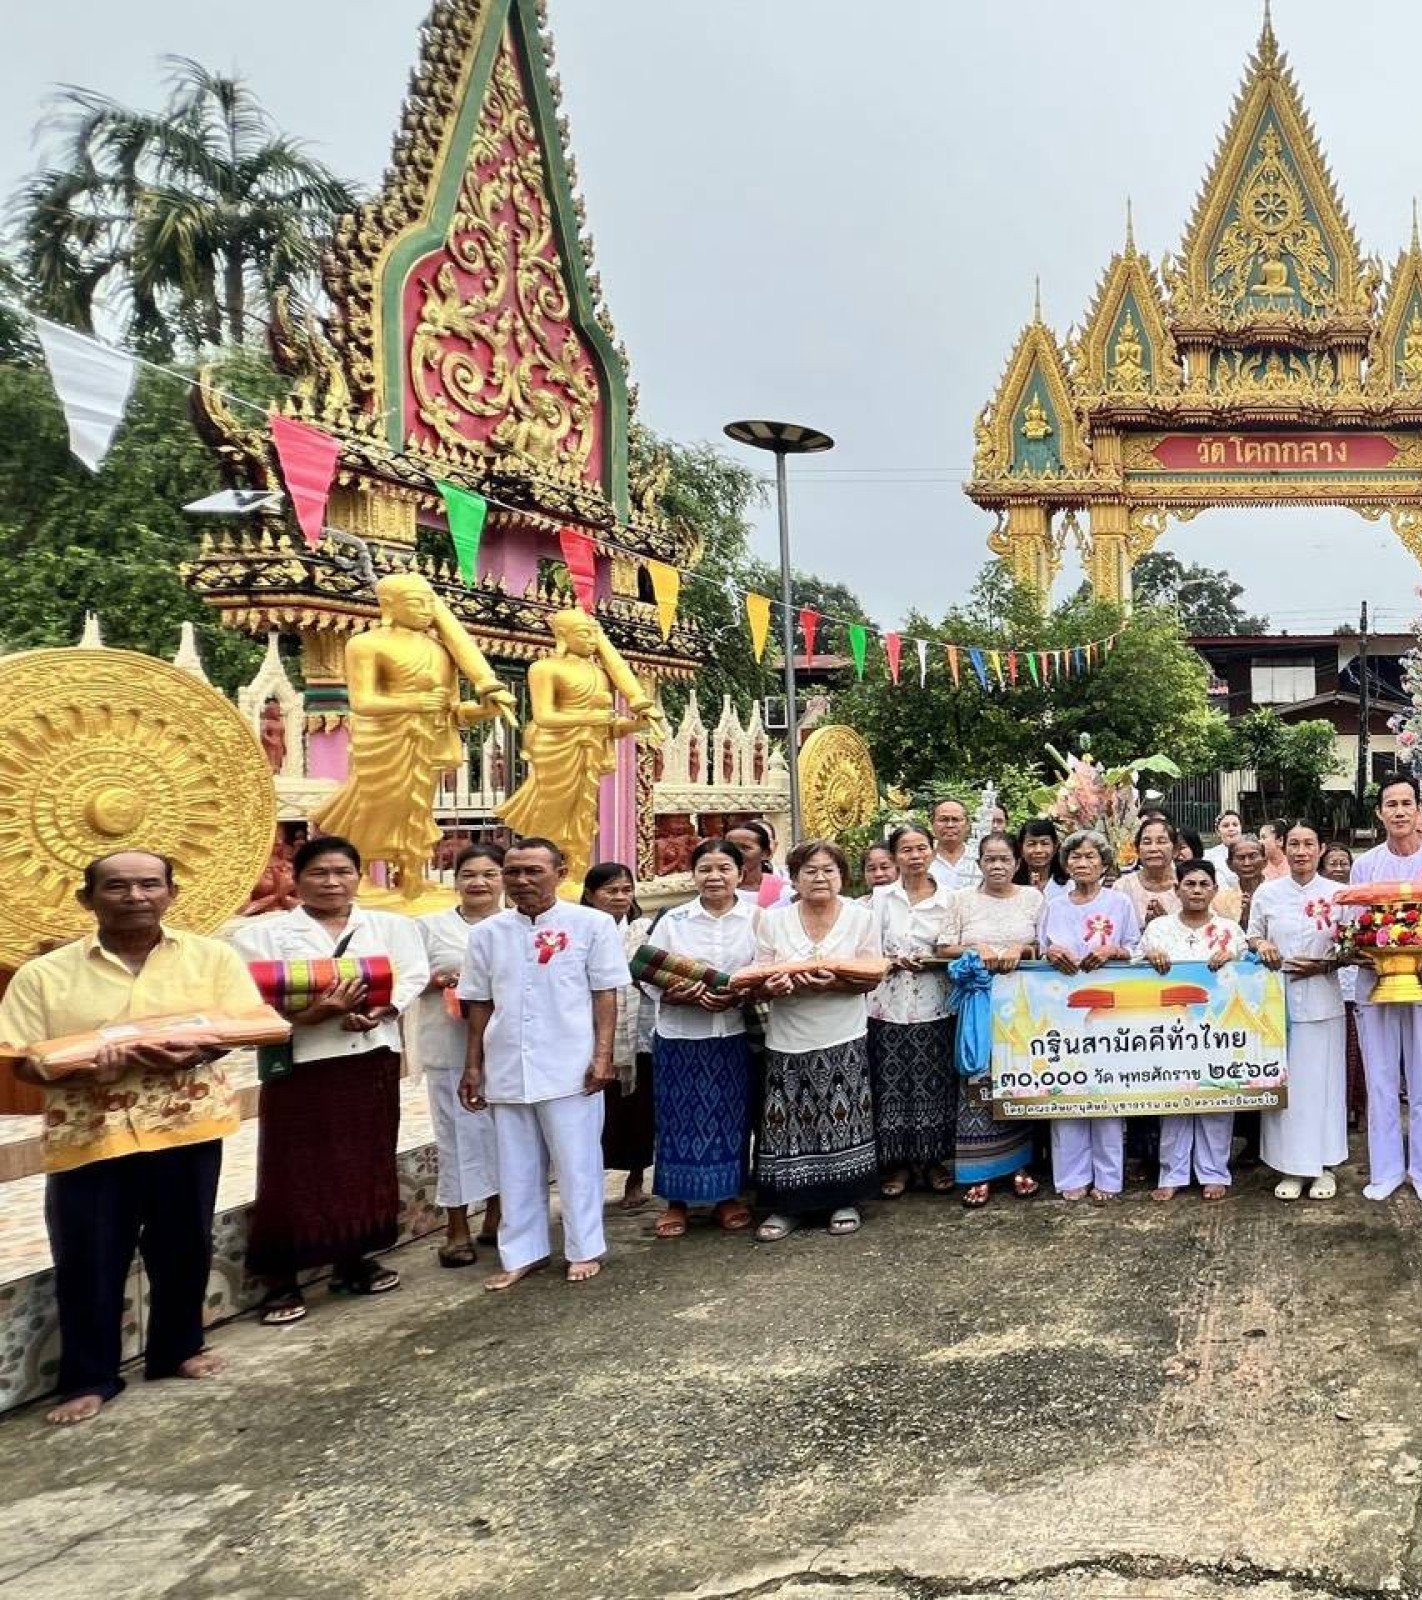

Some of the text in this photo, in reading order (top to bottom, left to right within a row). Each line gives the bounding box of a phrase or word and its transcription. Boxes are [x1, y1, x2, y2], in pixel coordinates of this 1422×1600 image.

[1030, 1018, 1247, 1062] กฐินสามัคคีทั่วไทย
[1000, 1060, 1280, 1092] ๓๐,๐๐๐ วัด พุทธศักราช ๒๕๖๘
